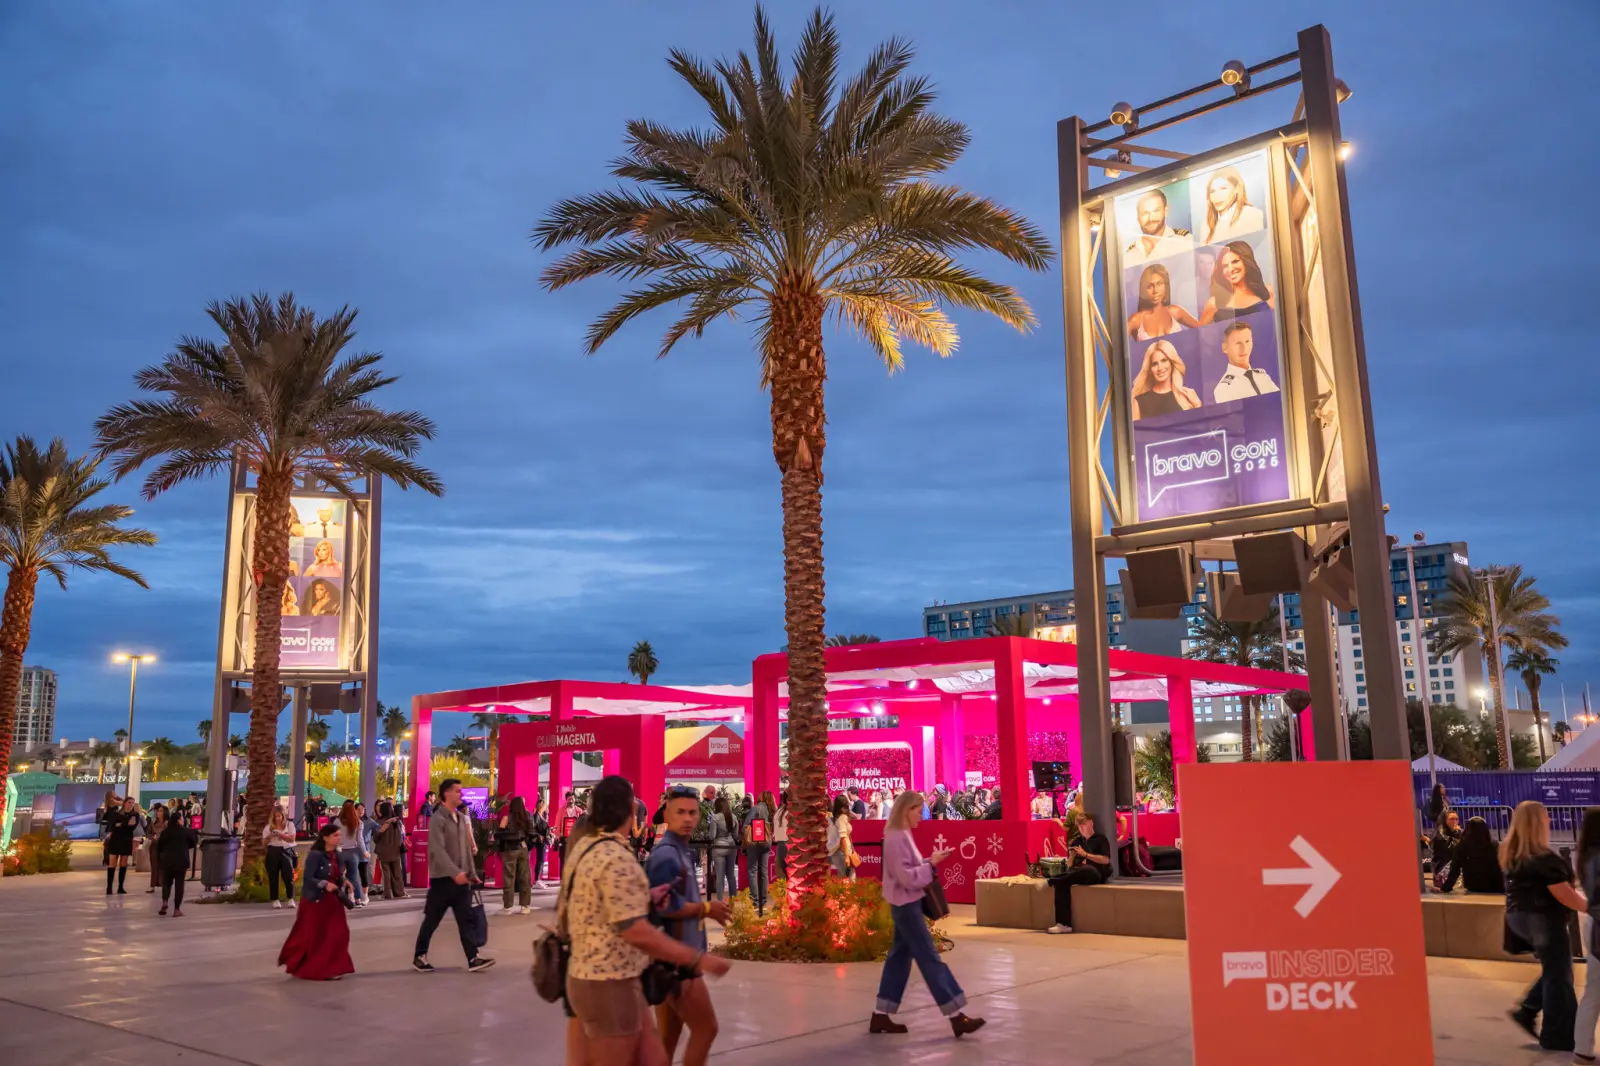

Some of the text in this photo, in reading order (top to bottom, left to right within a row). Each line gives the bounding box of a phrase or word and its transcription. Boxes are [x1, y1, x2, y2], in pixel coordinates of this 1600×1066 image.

[1153, 438, 1278, 476] bravo CON
[1233, 456, 1279, 474] 2025
[280, 636, 335, 646] avo CON
[710, 741, 728, 749] bravo
[1226, 948, 1394, 978] bravo INSIDER
[1266, 981, 1358, 1011] DECK
